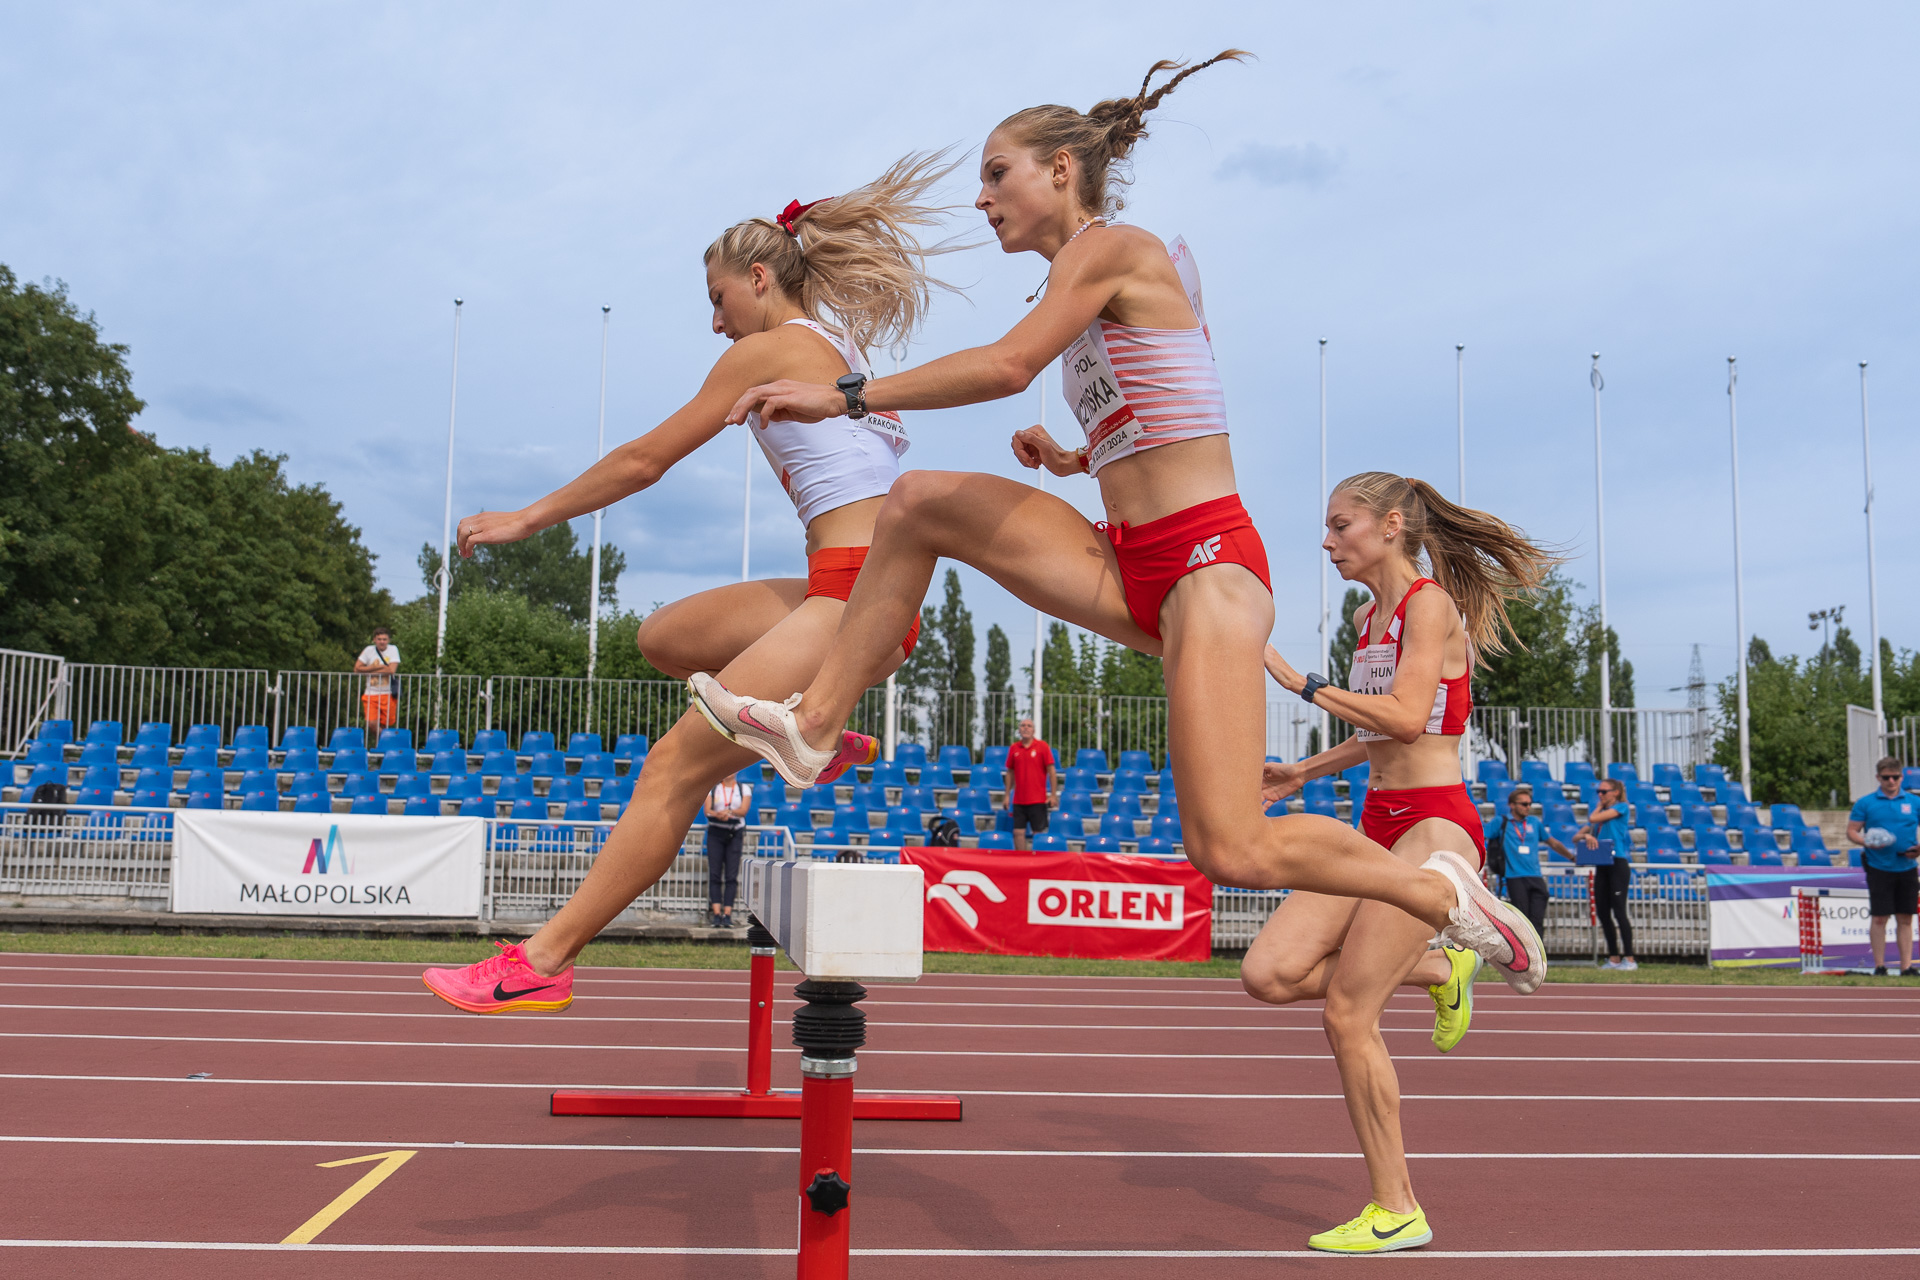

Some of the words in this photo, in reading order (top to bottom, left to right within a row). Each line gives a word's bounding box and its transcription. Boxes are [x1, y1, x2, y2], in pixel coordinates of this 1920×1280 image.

[1074, 354, 1098, 379] POL
[867, 415, 898, 432] KRAKÓW
[1371, 667, 1393, 678] HUN
[240, 882, 411, 905] MAŁOPOLSKA
[1038, 887, 1173, 922] ORLEN
